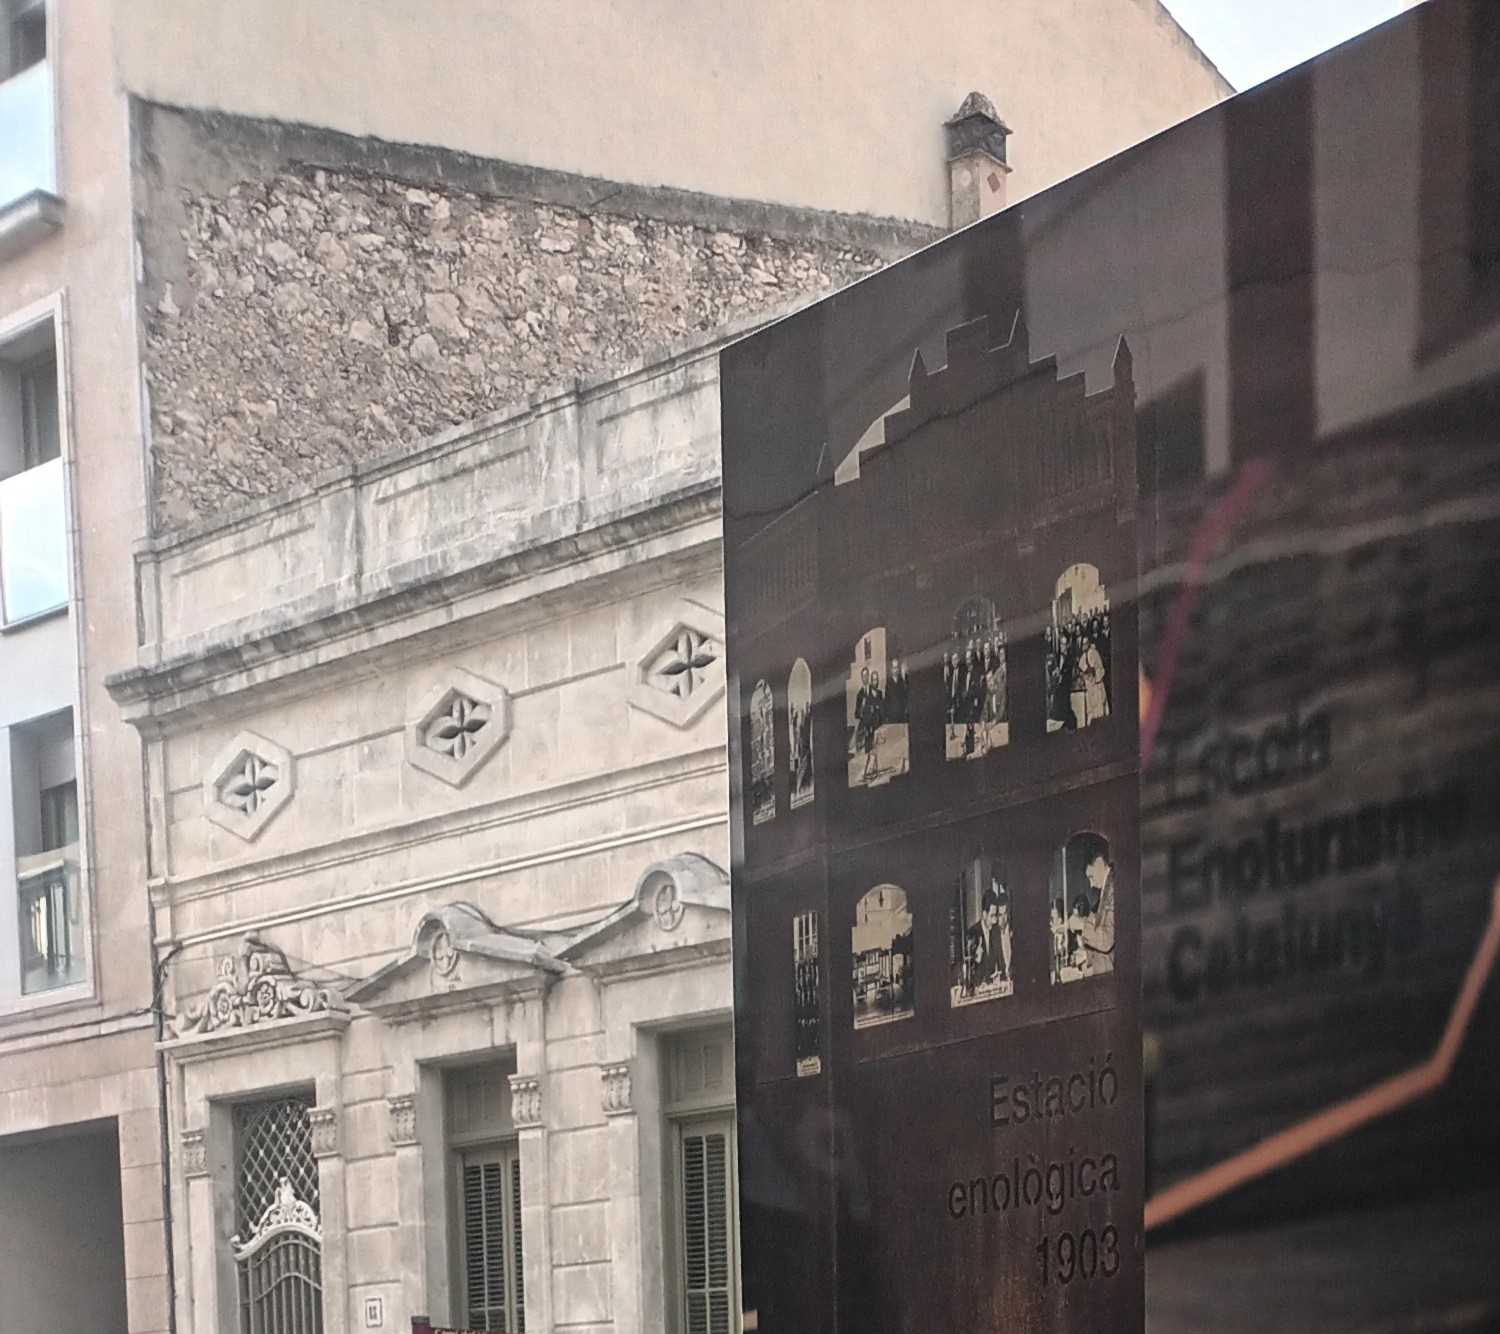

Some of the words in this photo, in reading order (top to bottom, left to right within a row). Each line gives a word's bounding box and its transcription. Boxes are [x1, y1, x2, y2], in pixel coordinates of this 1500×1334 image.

[988, 1051, 1119, 1130] Estació
[948, 1146, 1120, 1220] enològica
[1037, 1224, 1121, 1288] 1903
